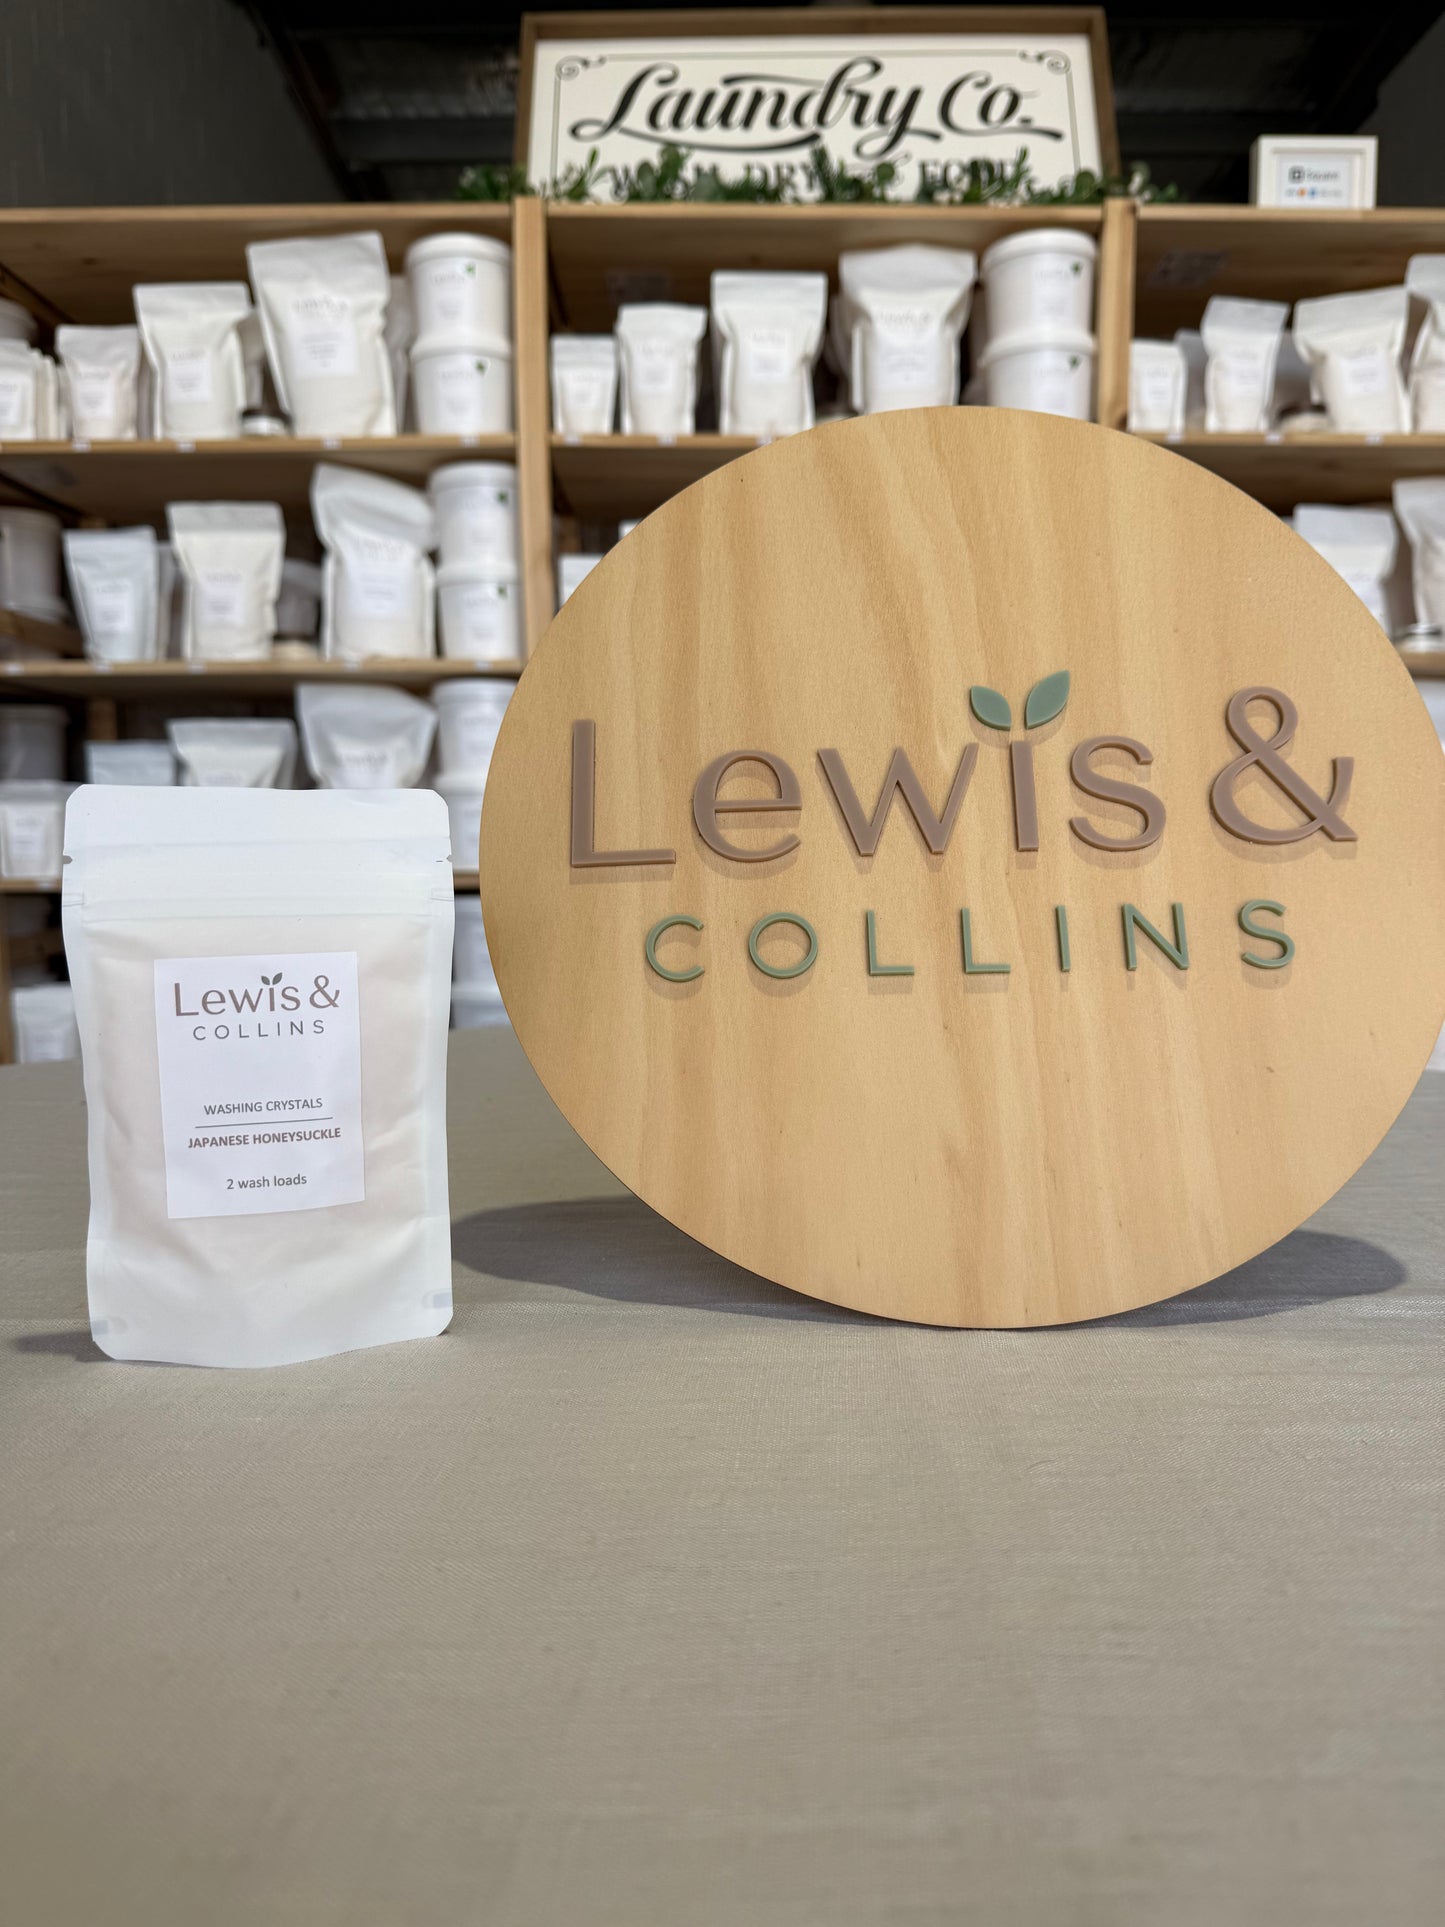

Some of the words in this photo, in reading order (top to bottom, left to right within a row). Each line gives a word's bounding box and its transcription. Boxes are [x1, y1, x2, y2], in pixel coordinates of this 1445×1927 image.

[568, 56, 942, 161] Laundry
[937, 70, 1065, 141] Co.
[571, 670, 1166, 870] Lewis
[1210, 686, 1358, 844] &
[645, 900, 1297, 984] COLLINS
[174, 972, 301, 1017] Lewis
[309, 974, 341, 1009] &
[192, 1019, 325, 1041] COLLINS
[204, 1101, 263, 1116] WASHING
[265, 1097, 323, 1112] CRYSTALS
[188, 1133, 250, 1148] JAPANESE
[252, 1127, 341, 1145] HONEYSUCKLE
[226, 1178, 235, 1190] 2
[237, 1175, 270, 1189] wash
[273, 1173, 308, 1187] loads
